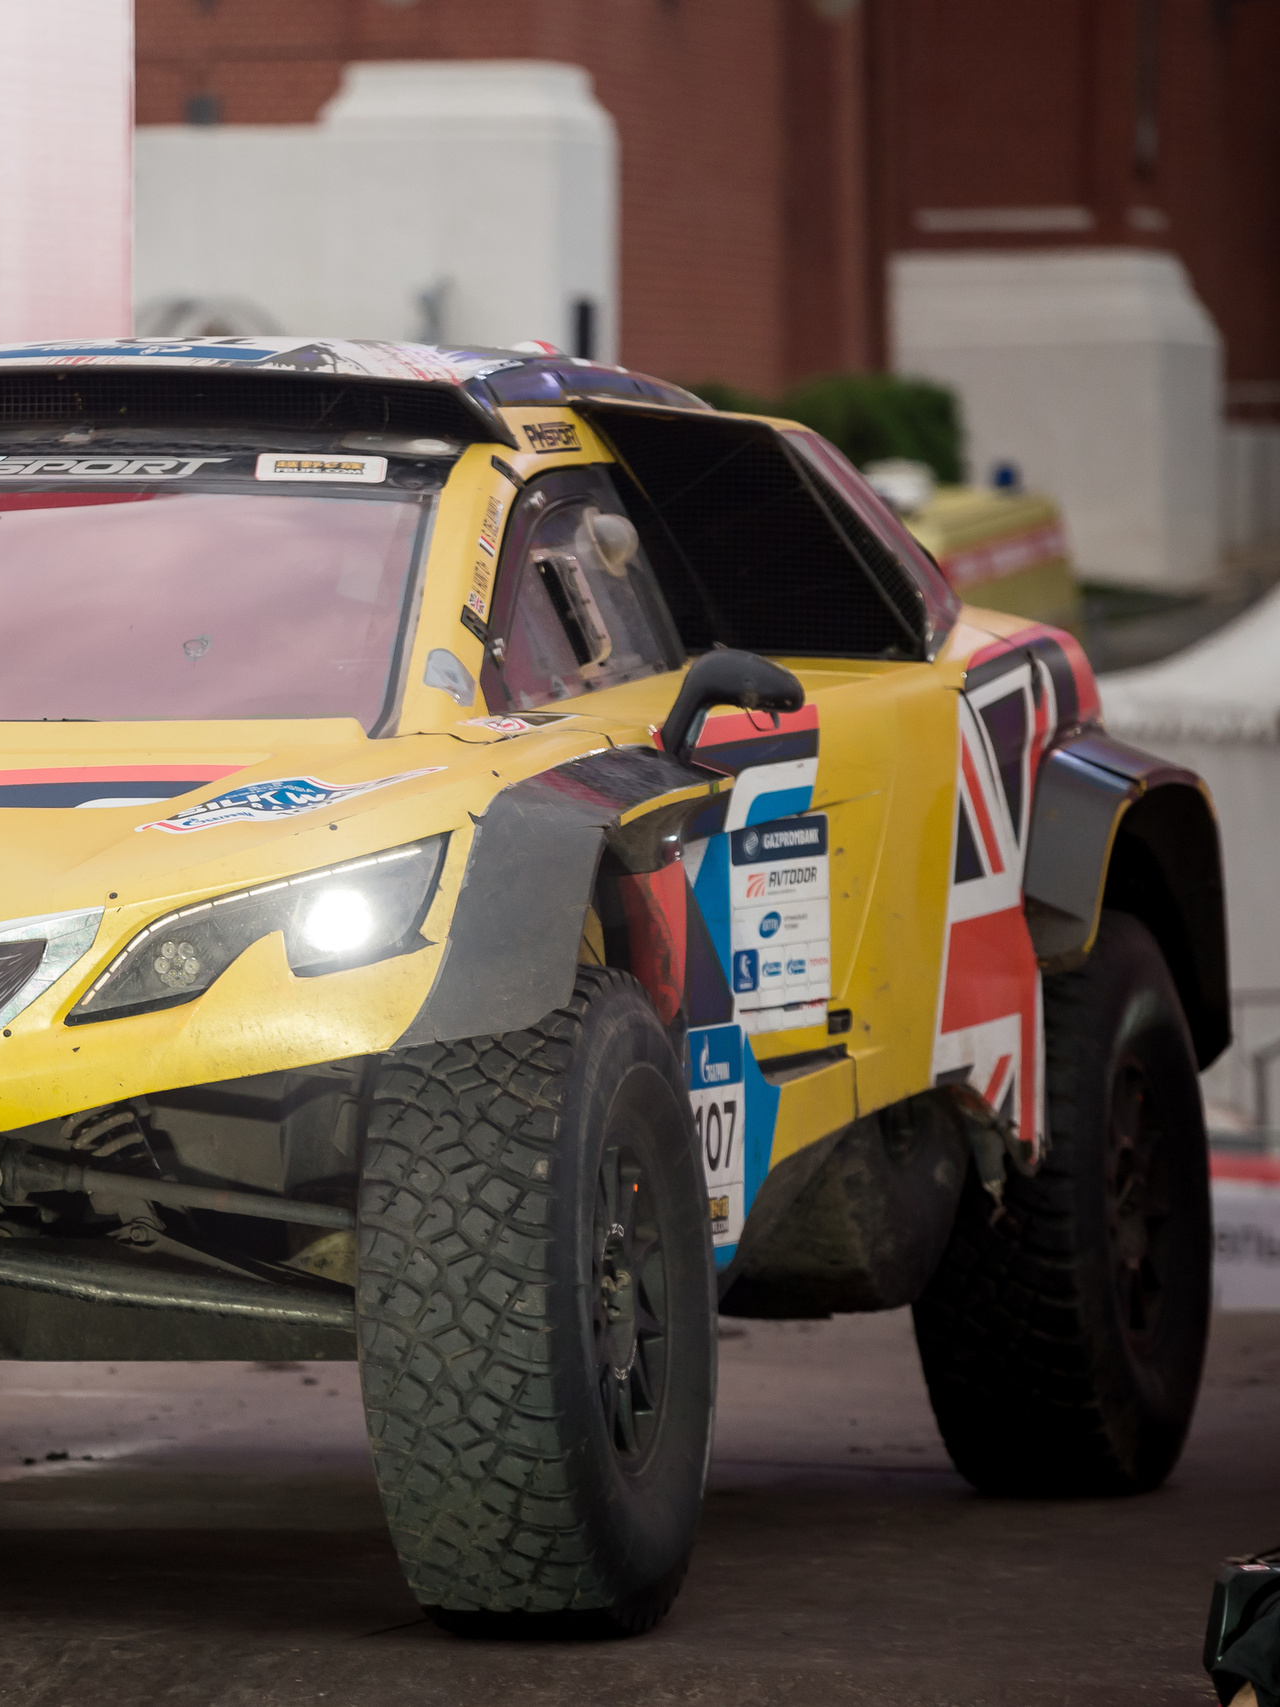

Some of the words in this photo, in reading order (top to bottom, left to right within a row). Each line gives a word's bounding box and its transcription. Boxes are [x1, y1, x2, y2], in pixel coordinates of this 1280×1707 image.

[762, 827, 820, 850] GAZPROMBANK
[768, 866, 817, 888] AVTODOR
[695, 1100, 737, 1172] 107
